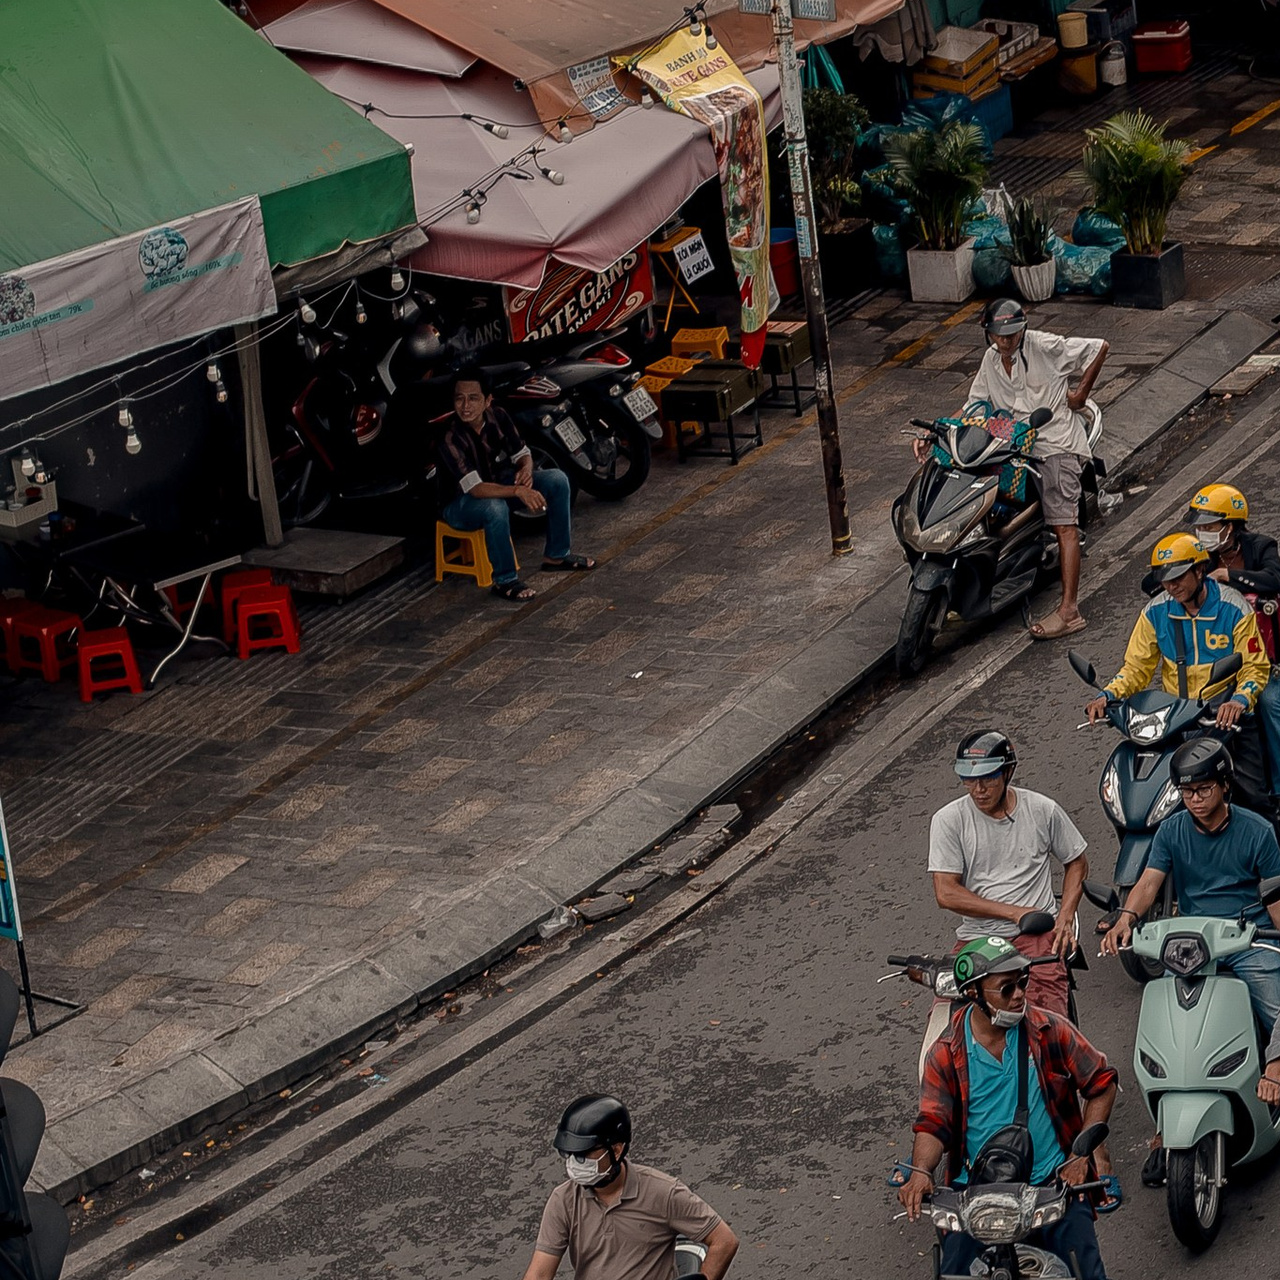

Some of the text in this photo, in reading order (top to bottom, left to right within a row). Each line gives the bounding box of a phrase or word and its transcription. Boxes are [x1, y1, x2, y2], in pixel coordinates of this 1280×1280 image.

[696, 56, 729, 78] GANS
[579, 252, 638, 310] GANS
[1157, 548, 1173, 560] be
[1205, 629, 1231, 650] be
